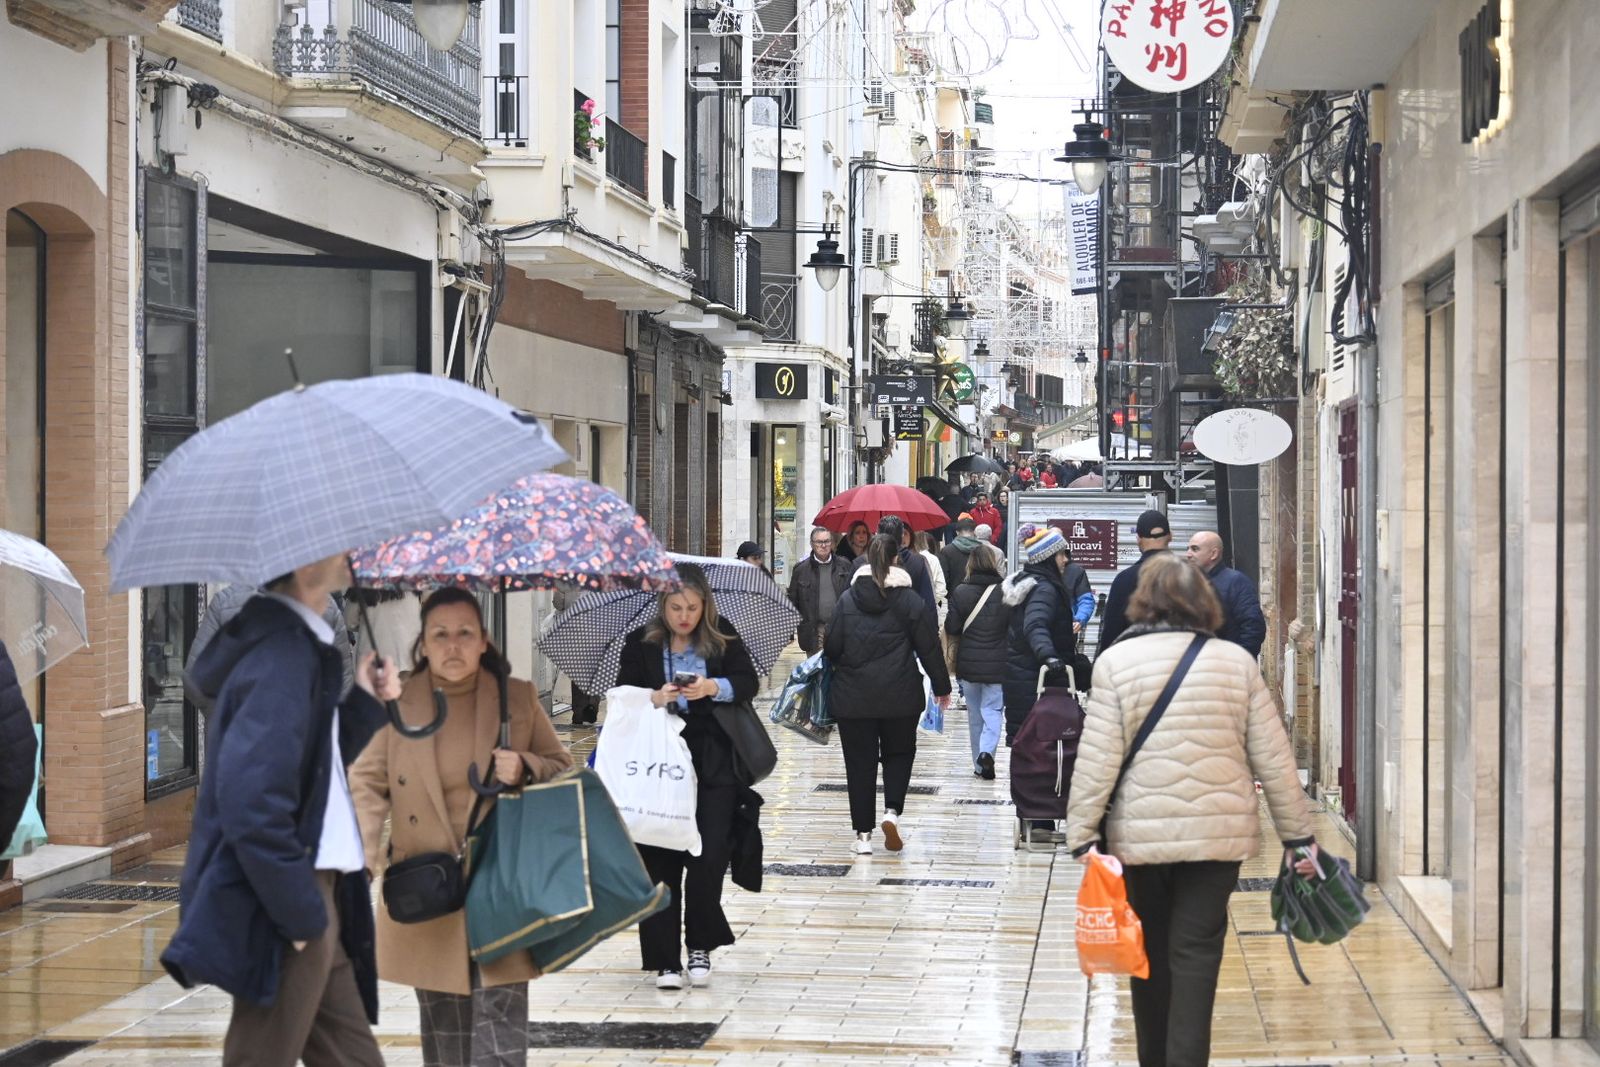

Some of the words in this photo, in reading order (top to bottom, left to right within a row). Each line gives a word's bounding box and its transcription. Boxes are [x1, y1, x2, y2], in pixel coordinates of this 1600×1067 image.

[1107, 0, 1135, 38] PA
[1071, 202, 1085, 216] DE
[1073, 219, 1089, 271] ALQUILER
[1085, 200, 1099, 269] ANDAMIOS
